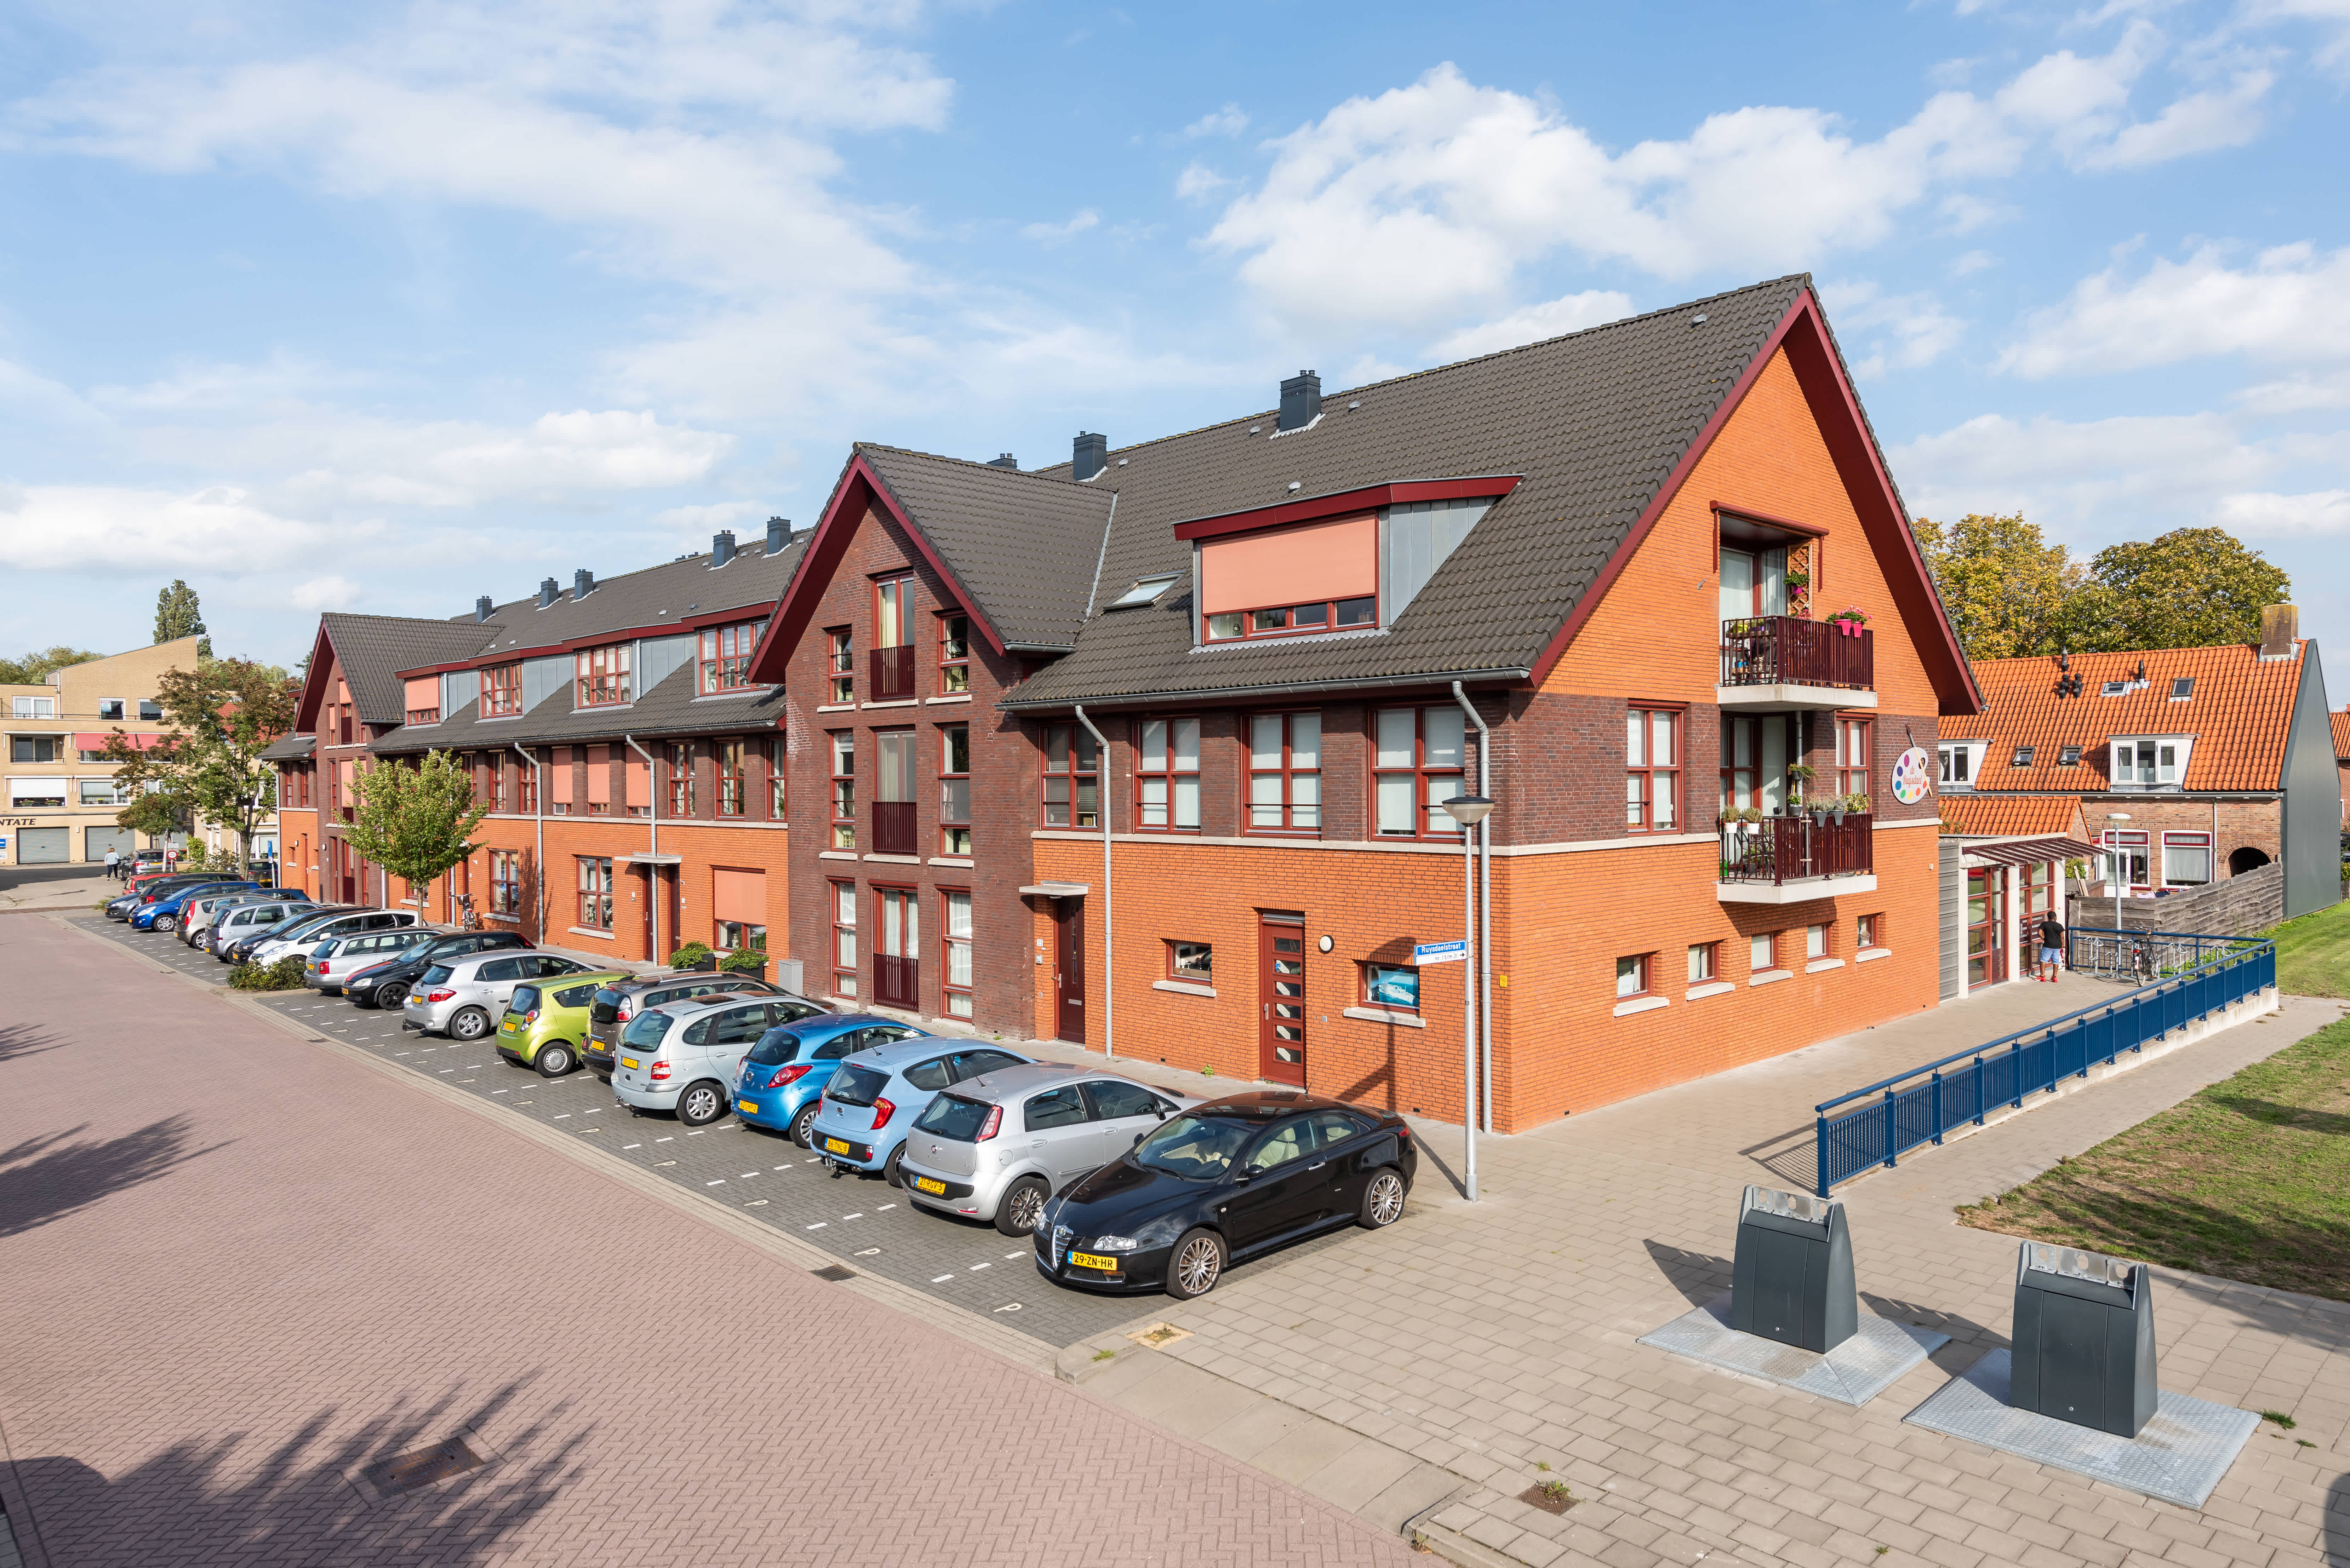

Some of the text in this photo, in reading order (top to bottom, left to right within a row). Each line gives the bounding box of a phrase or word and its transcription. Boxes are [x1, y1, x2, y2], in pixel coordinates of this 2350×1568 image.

[1910, 765, 1915, 775] de
[1422, 942, 1461, 954] Ruysdaelstraat
[741, 1101, 756, 1112] 62-LHP-2
[828, 1140, 847, 1152] 86-TNL-8
[920, 1177, 942, 1191] 21-RGV-5
[1075, 1254, 1113, 1268] 29-ZN-HR
[994, 1303, 1022, 1312] P
